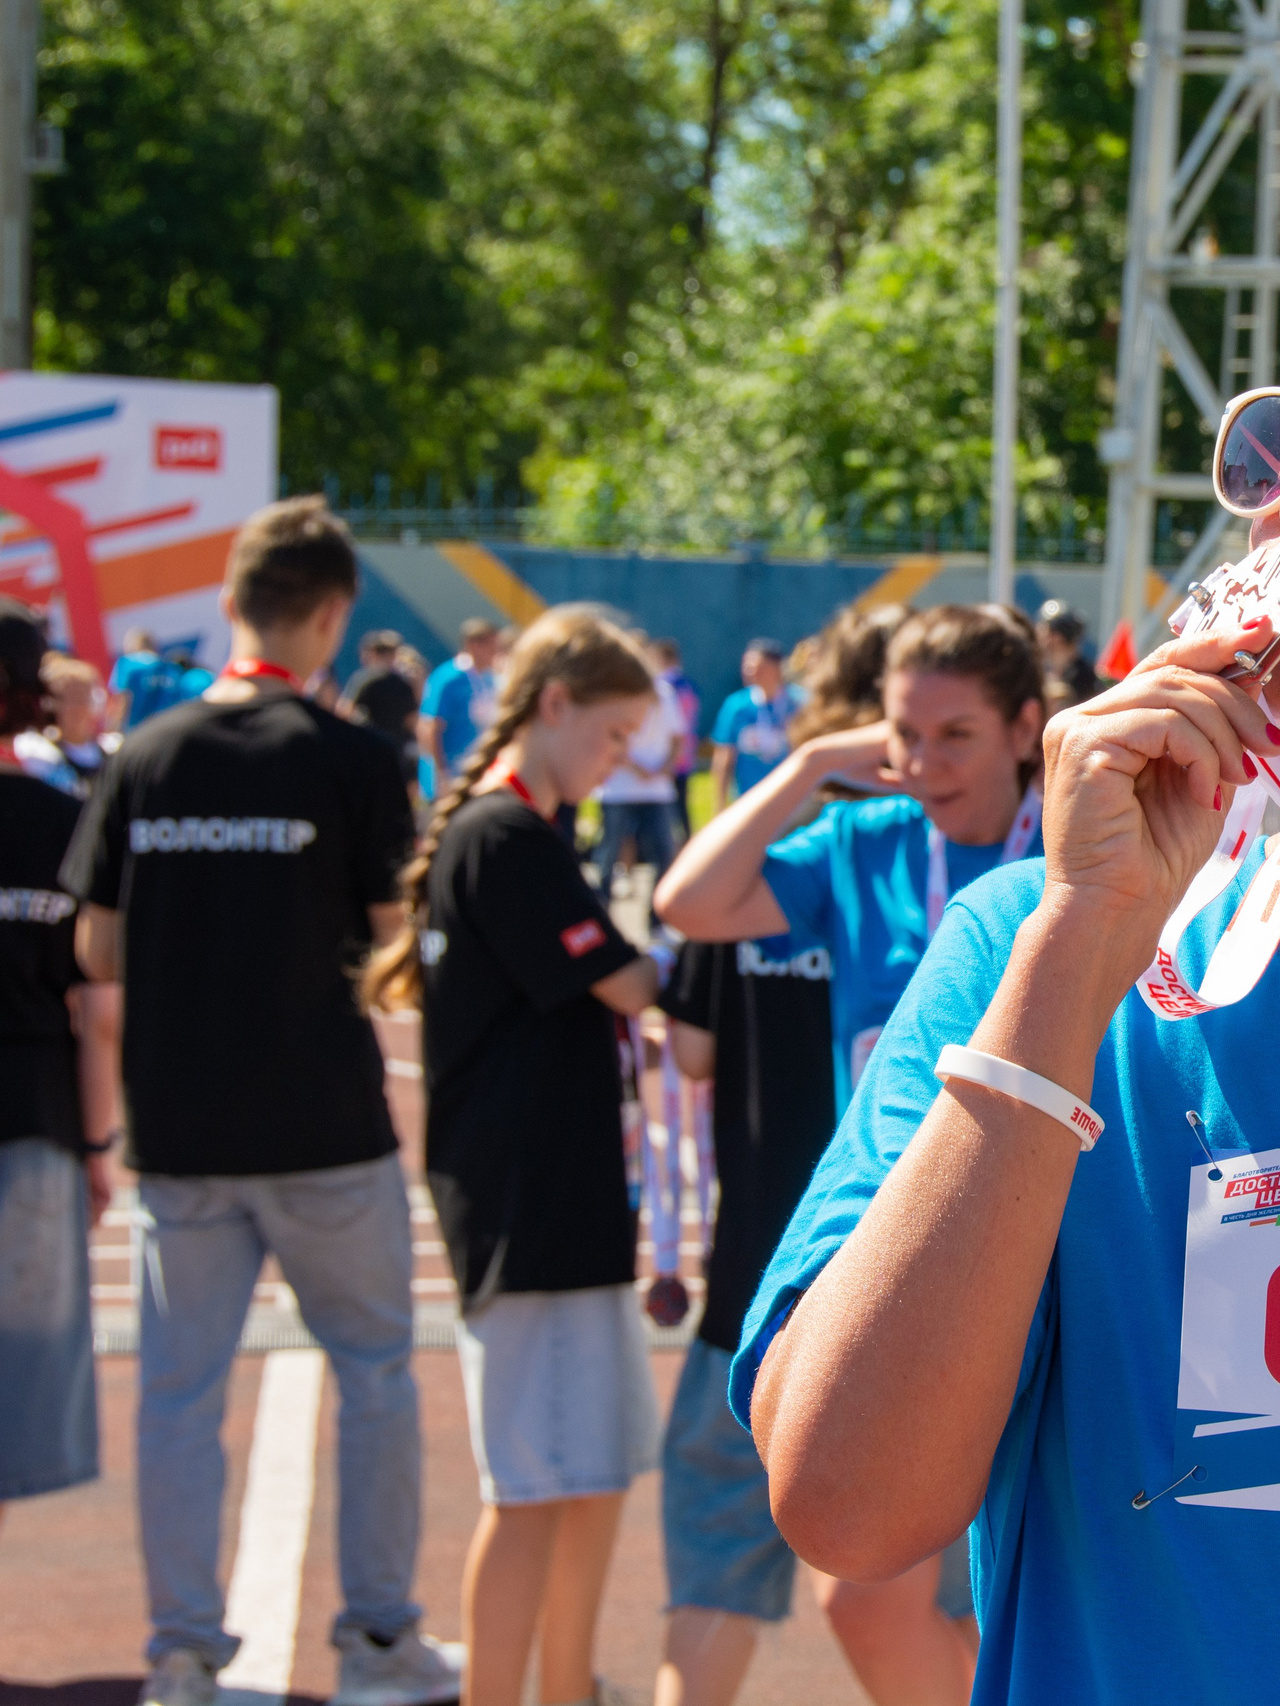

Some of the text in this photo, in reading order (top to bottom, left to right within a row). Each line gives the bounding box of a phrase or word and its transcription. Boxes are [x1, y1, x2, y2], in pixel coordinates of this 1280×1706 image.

[129, 816, 317, 854] ВОЛОНТЕР
[1229, 1213, 1245, 1221] ЧЕСТЬ
[1245, 1211, 1258, 1219] ДНЯ
